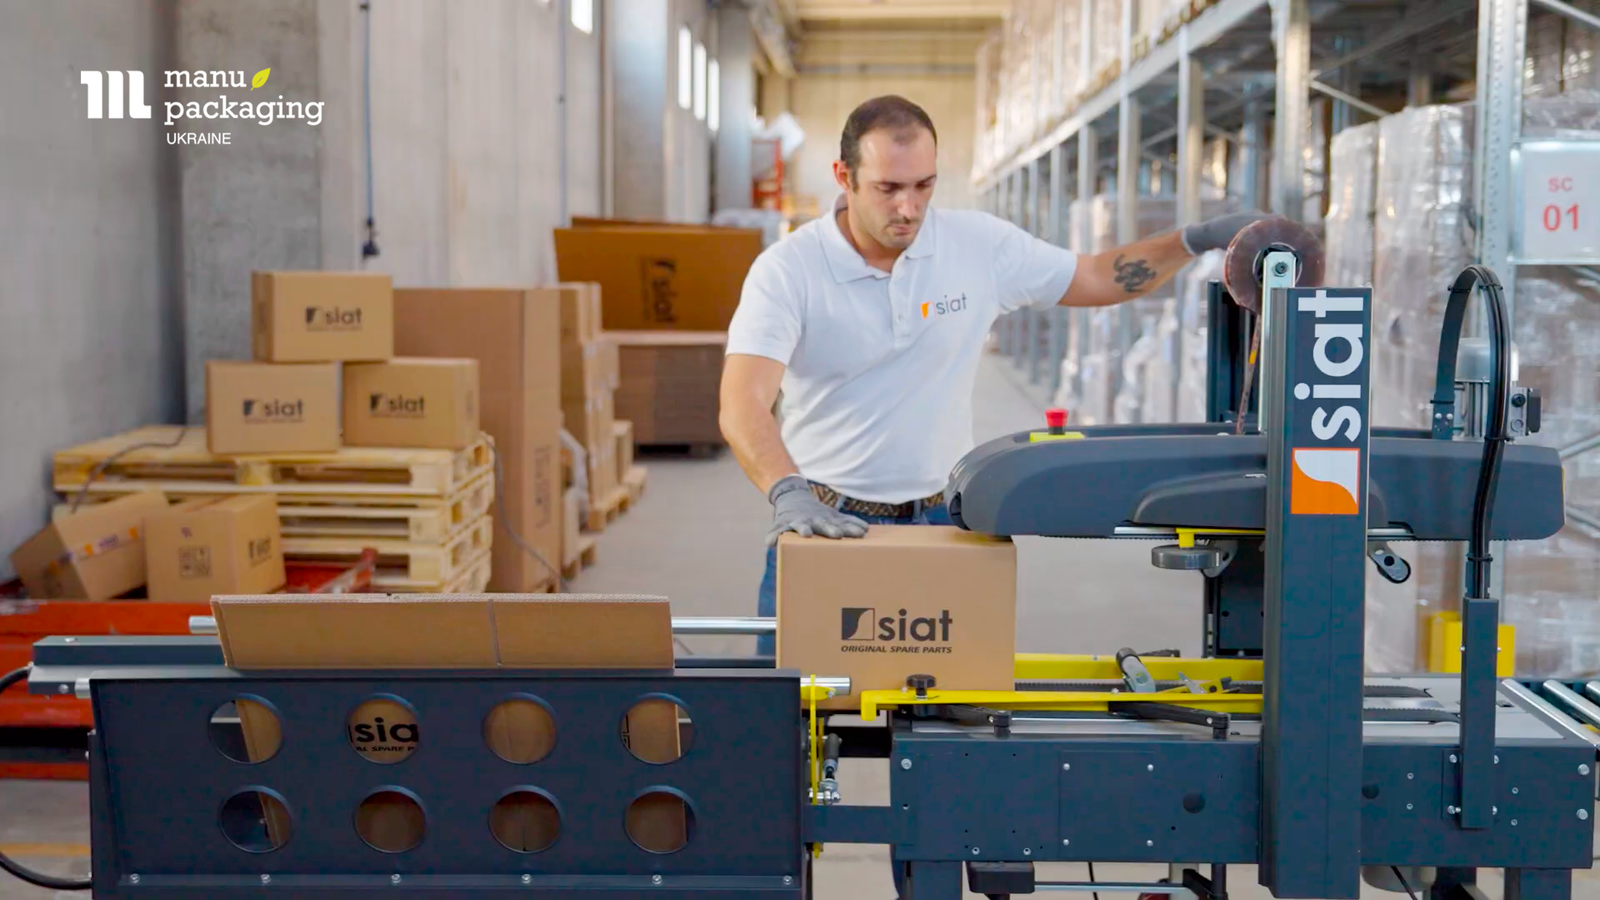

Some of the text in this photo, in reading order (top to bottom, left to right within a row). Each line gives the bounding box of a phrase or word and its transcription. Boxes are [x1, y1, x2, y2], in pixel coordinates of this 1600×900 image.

[1548, 177, 1573, 192] SC
[1543, 203, 1579, 231] 01
[936, 291, 967, 315] siat
[325, 306, 363, 325] siat
[1294, 289, 1364, 443] siat
[264, 399, 303, 417] siat
[878, 608, 953, 641] siat
[841, 645, 887, 653] ORIGINAL
[355, 717, 419, 743] sia
